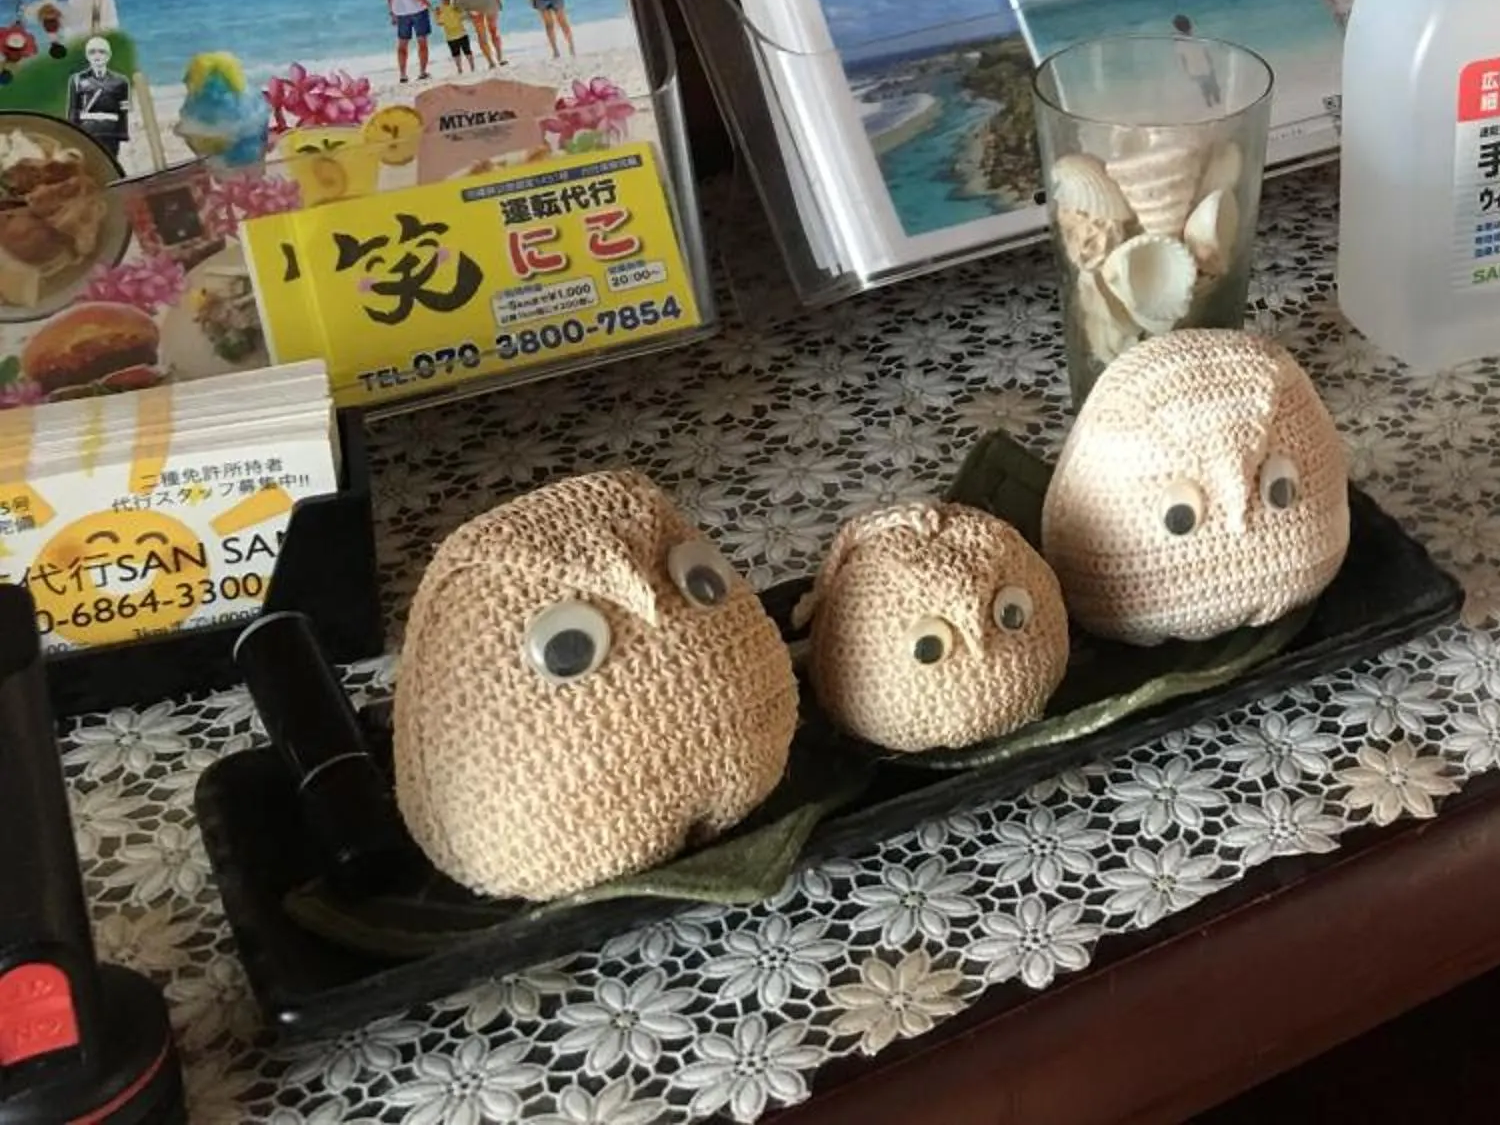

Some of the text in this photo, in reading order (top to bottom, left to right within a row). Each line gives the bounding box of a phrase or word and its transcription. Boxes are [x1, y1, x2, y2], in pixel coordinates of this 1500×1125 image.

[499, 177, 618, 226] 運転代行
[333, 212, 484, 325] 笑
[506, 207, 641, 279] にこ
[140, 457, 285, 491] 二種免許所持者
[0, 541, 208, 595] 代行SAN
